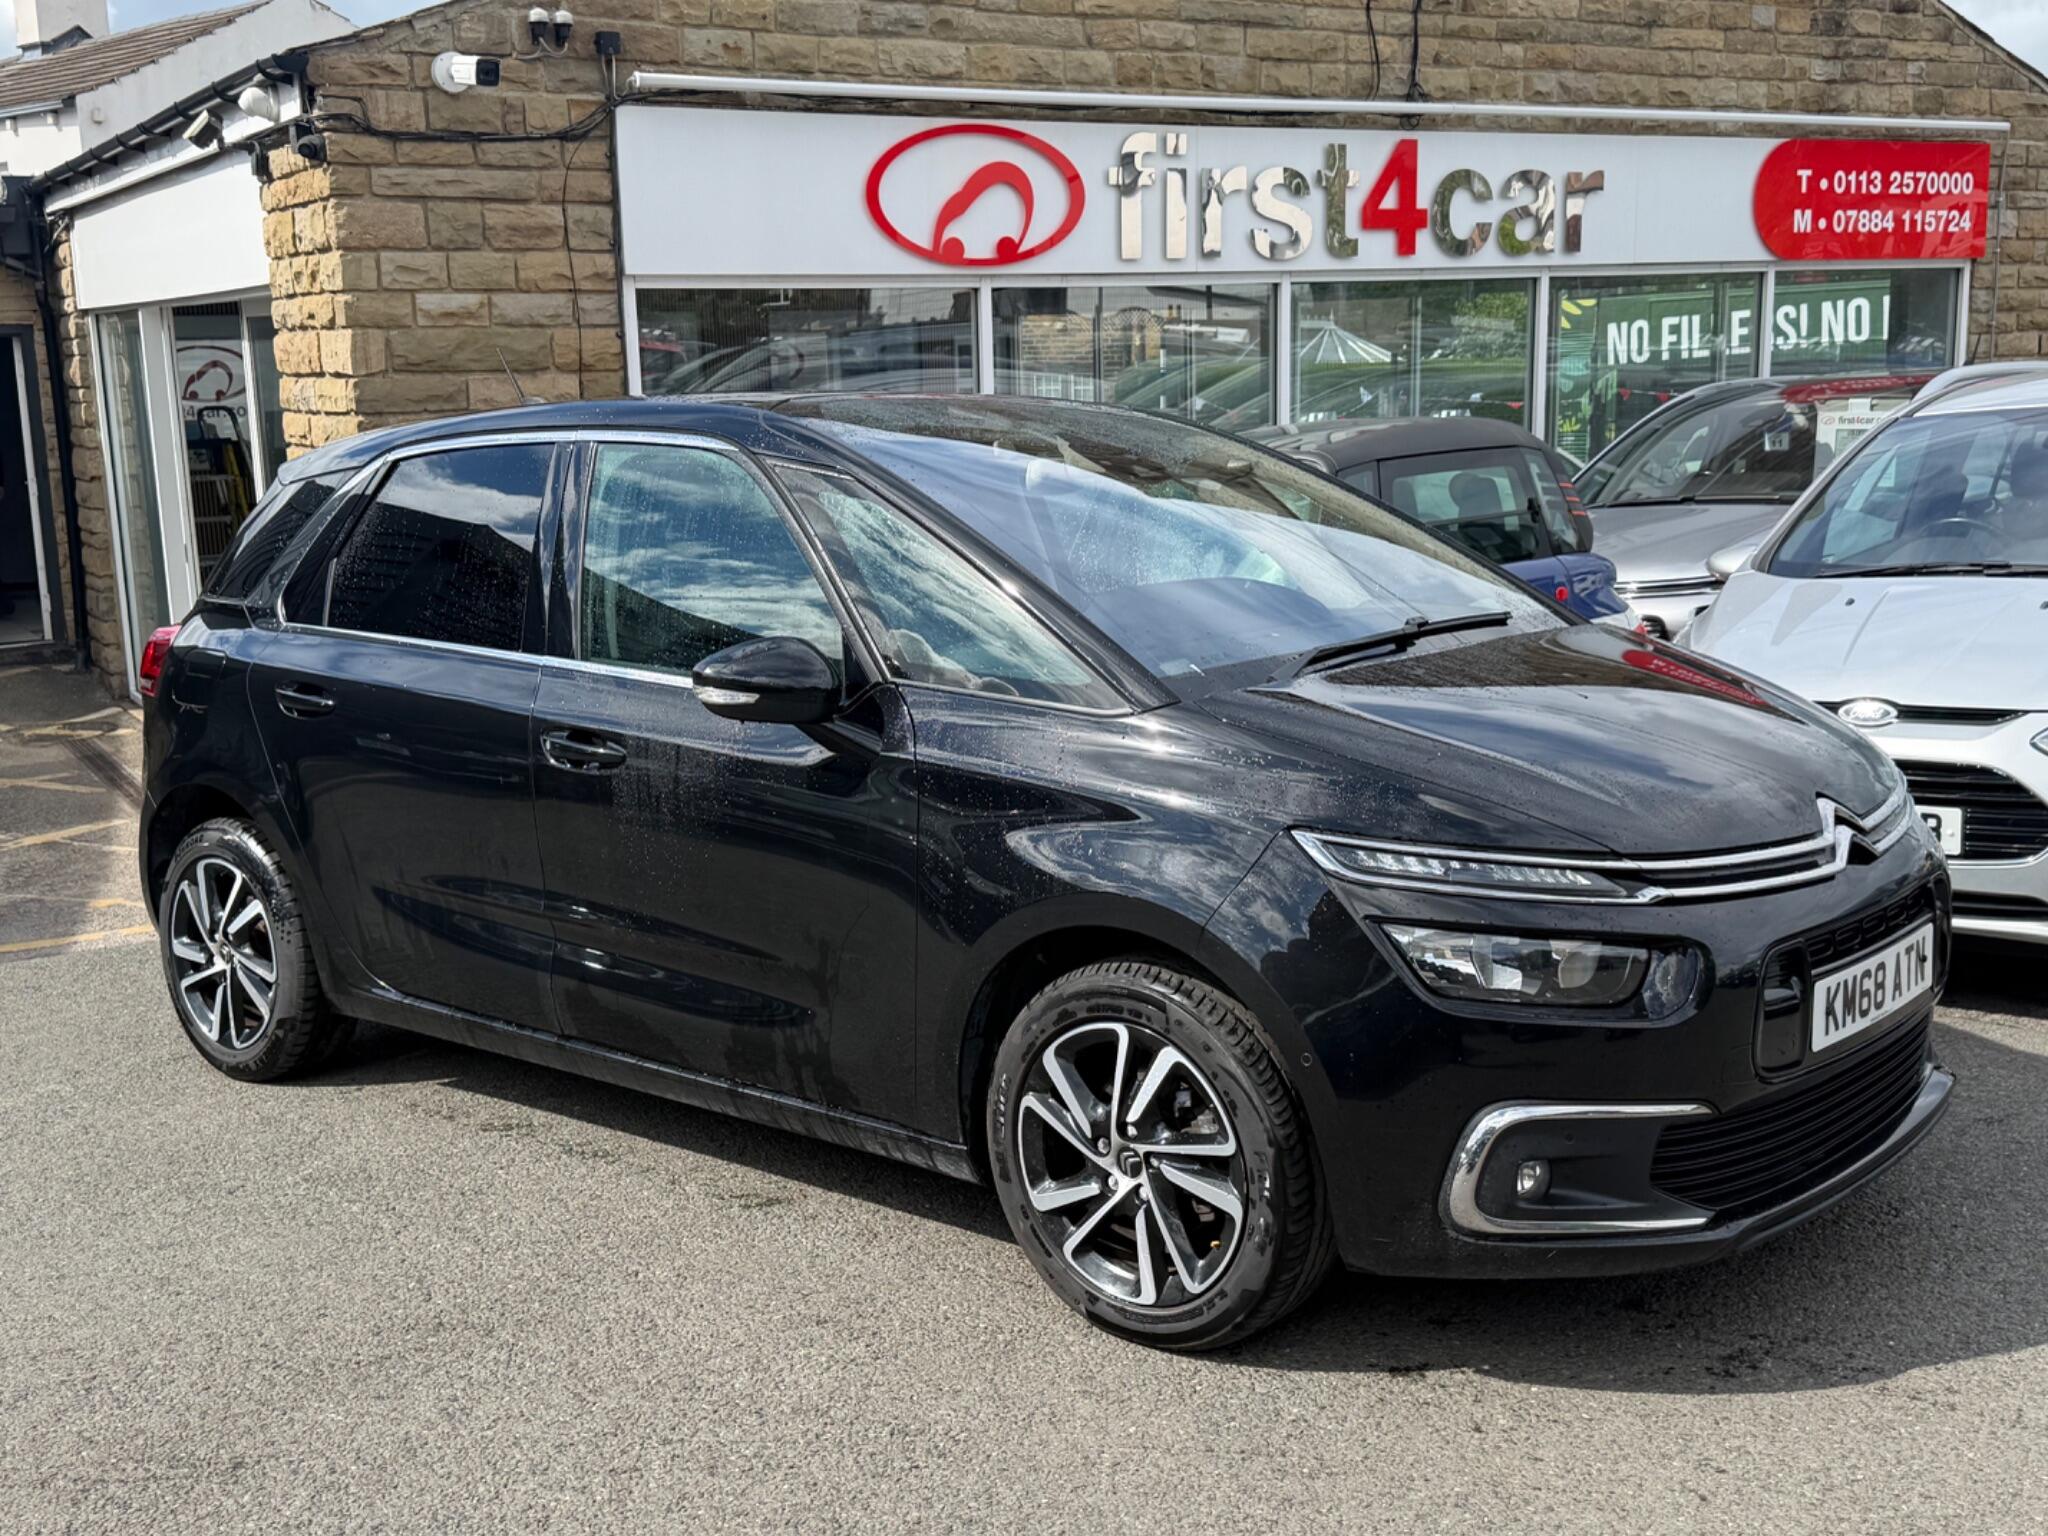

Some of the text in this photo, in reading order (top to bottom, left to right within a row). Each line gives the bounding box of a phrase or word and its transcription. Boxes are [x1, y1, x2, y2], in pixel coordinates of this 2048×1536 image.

[1108, 131, 1605, 261] first4car
[1797, 169, 1974, 195] T 0113 2570000
[1793, 208, 1971, 233] M 07884 115724
[1607, 318, 1650, 366] NO
[1661, 303, 1808, 361] FILES!
[1821, 297, 1870, 346] NO
[1825, 936, 1926, 1036] KM68 ATN
